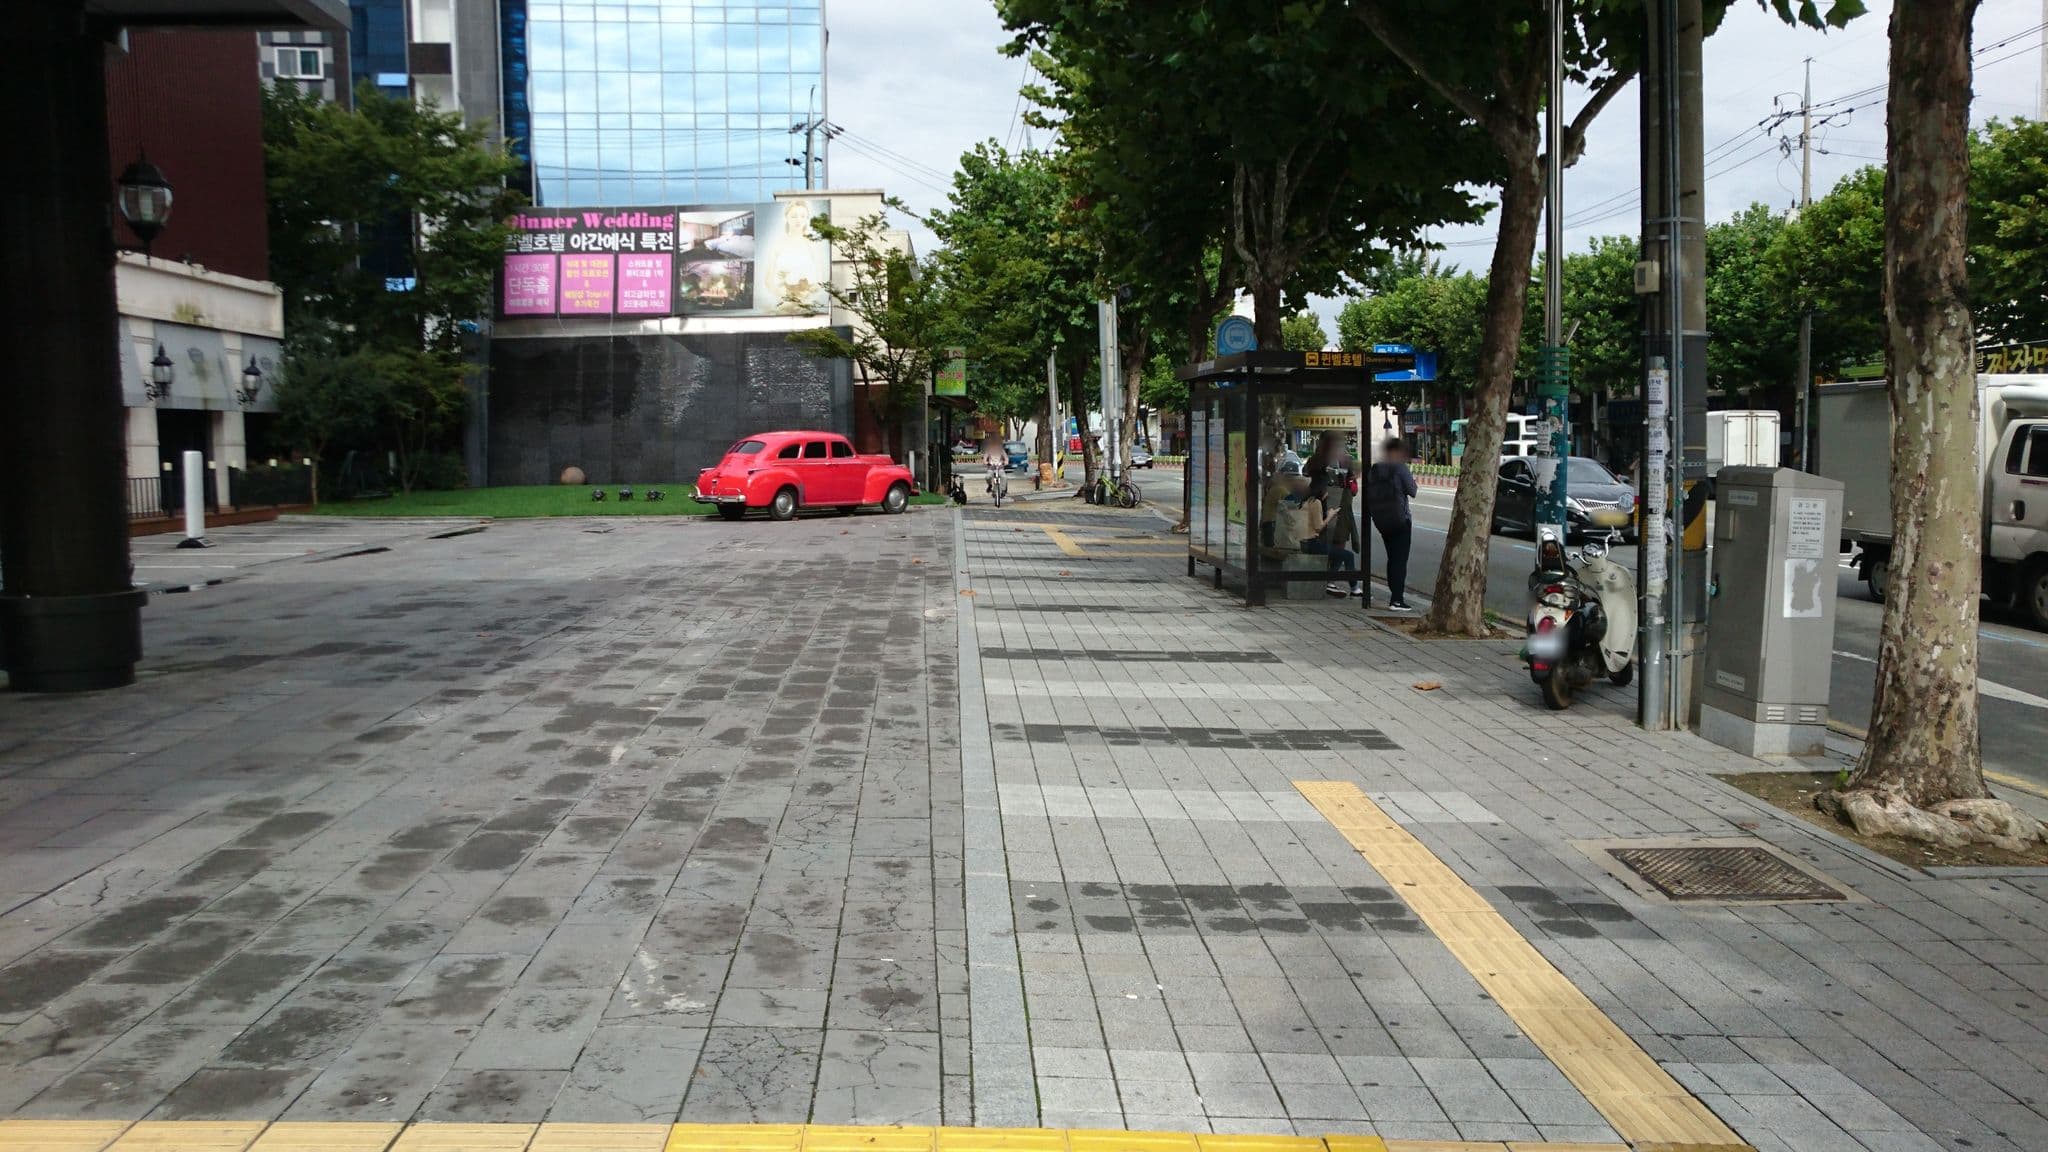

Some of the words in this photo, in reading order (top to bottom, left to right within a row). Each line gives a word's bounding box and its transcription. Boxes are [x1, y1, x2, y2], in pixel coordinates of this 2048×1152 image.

[582, 212, 674, 231] Wedding
[570, 232, 635, 251] 야간예식
[641, 232, 674, 251] 특전
[509, 276, 550, 295] 단독홀
